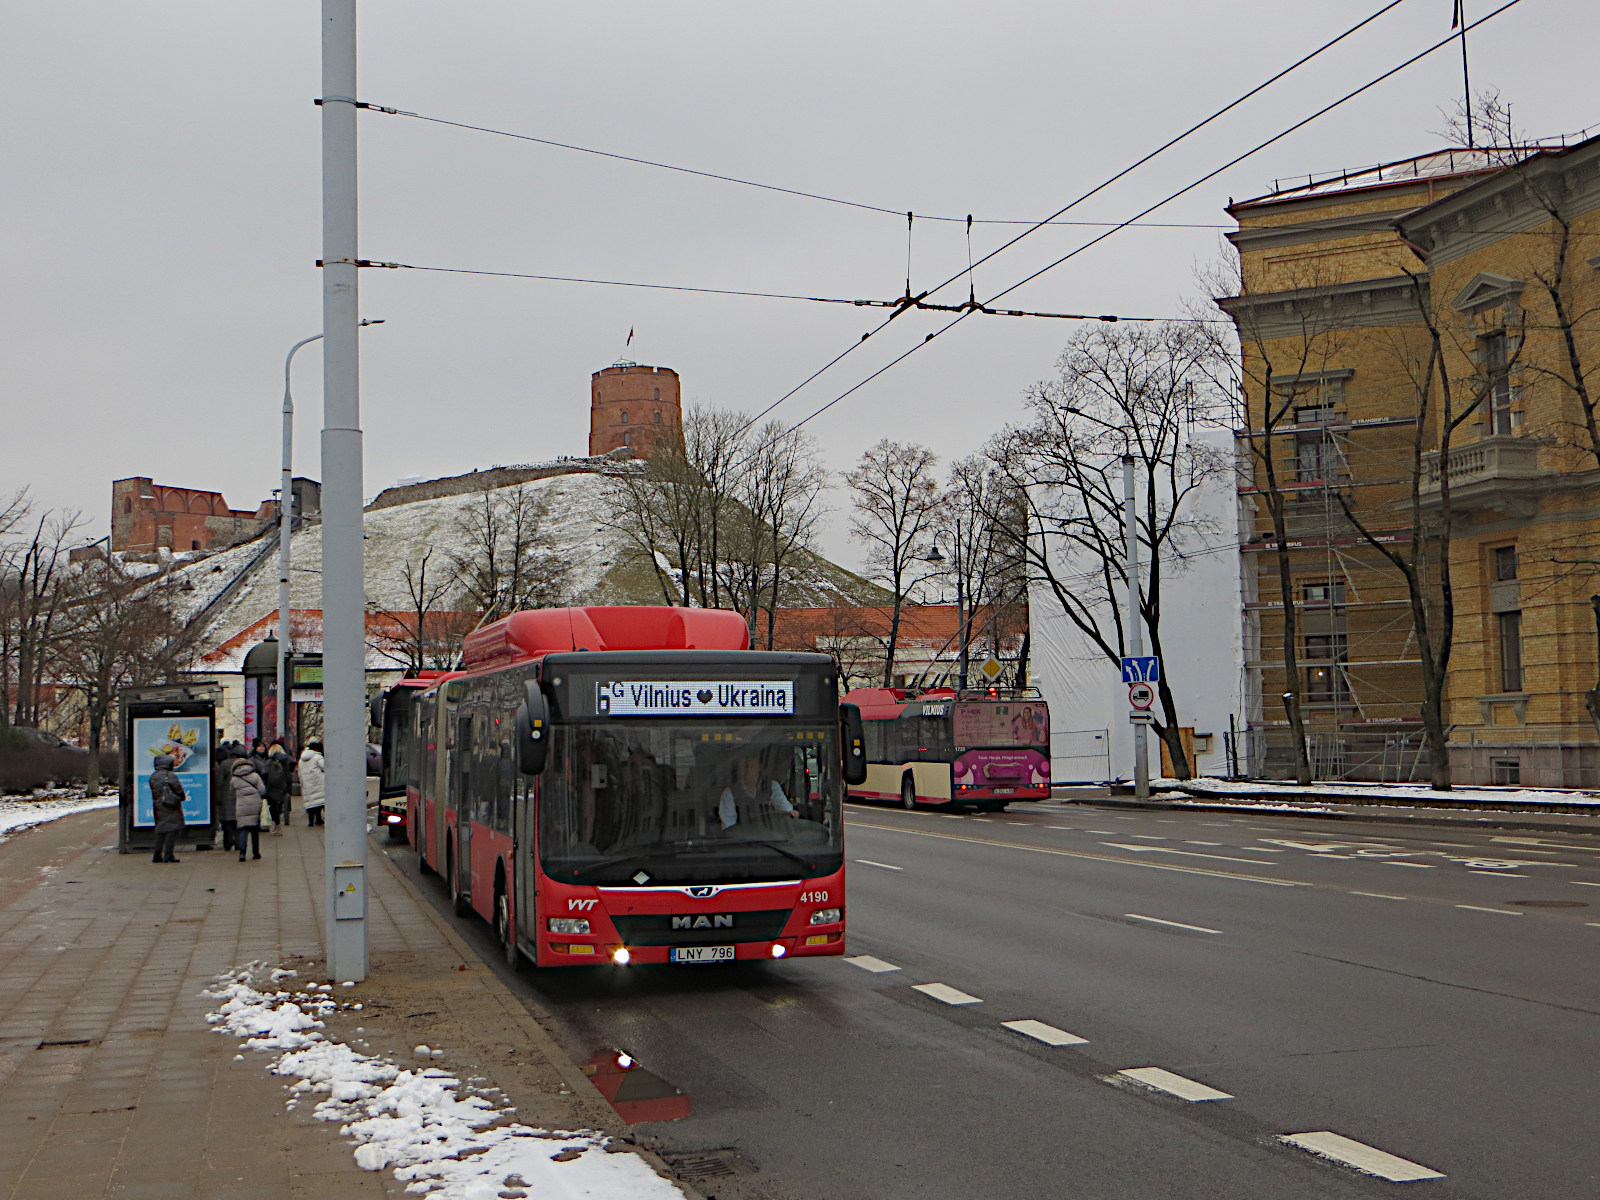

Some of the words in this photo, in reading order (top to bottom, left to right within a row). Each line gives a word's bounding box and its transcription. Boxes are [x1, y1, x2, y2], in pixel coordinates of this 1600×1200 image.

[631, 685, 692, 707] Vilnius
[718, 684, 788, 712] Ukrainą
[800, 890, 829, 903] 4190
[672, 915, 733, 929] MAN
[677, 950, 702, 960] LNY
[711, 947, 733, 958] 796
